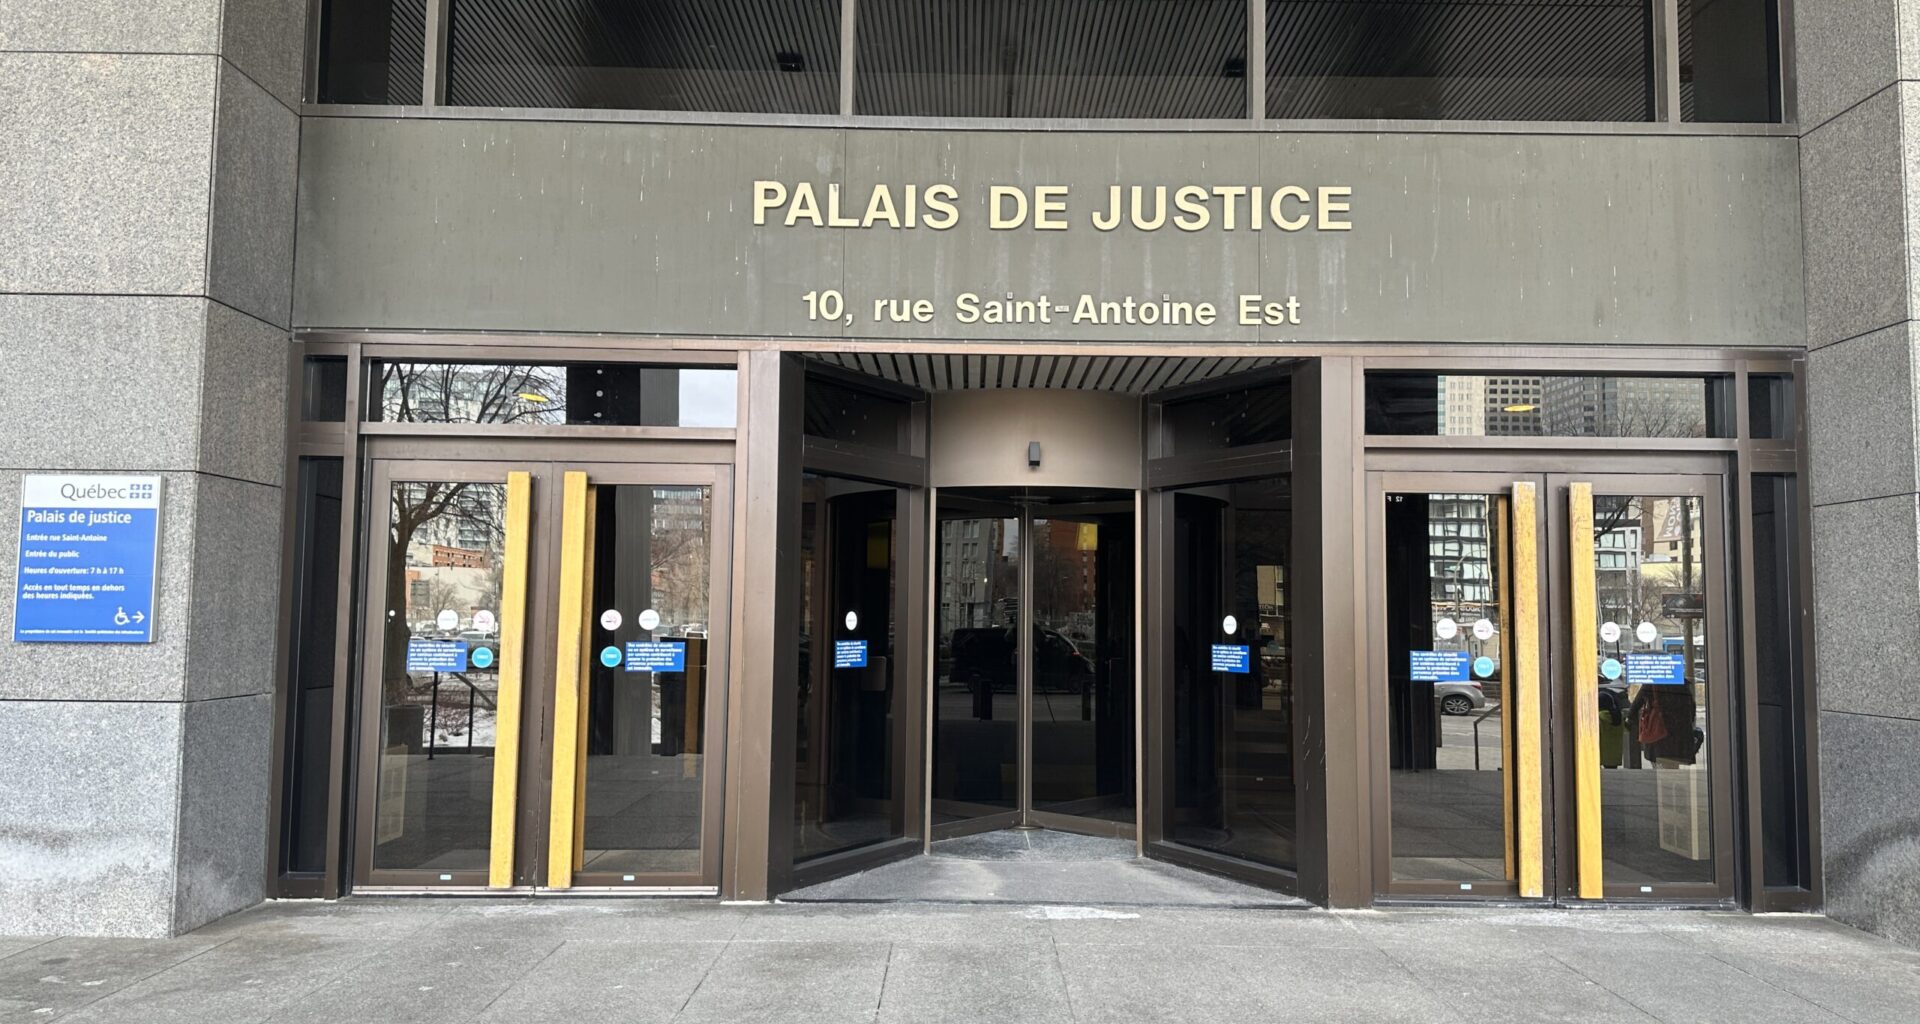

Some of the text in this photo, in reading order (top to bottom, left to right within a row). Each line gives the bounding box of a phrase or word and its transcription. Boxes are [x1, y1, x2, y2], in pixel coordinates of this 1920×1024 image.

[753, 180, 1352, 232] PALAIS DE JUSTICE
[802, 290, 1301, 326] 10, rue Saint-Antoine Est
[60, 483, 127, 502] Québec
[27, 510, 132, 526] Palais de justice
[26, 533, 48, 542] Entrée
[62, 533, 108, 542] Saint-Antoine
[25, 549, 80, 560] Entrée du public
[23, 566, 47, 575] Heures
[90, 566, 96, 575] 7
[96, 566, 102, 575] h
[109, 566, 118, 575] 17
[118, 567, 124, 575] h
[23, 583, 42, 592] Accès
[54, 584, 68, 592] tout
[69, 584, 91, 594] temps
[101, 584, 125, 592] dehors
[22, 591, 35, 600] des
[35, 591, 59, 600] heures
